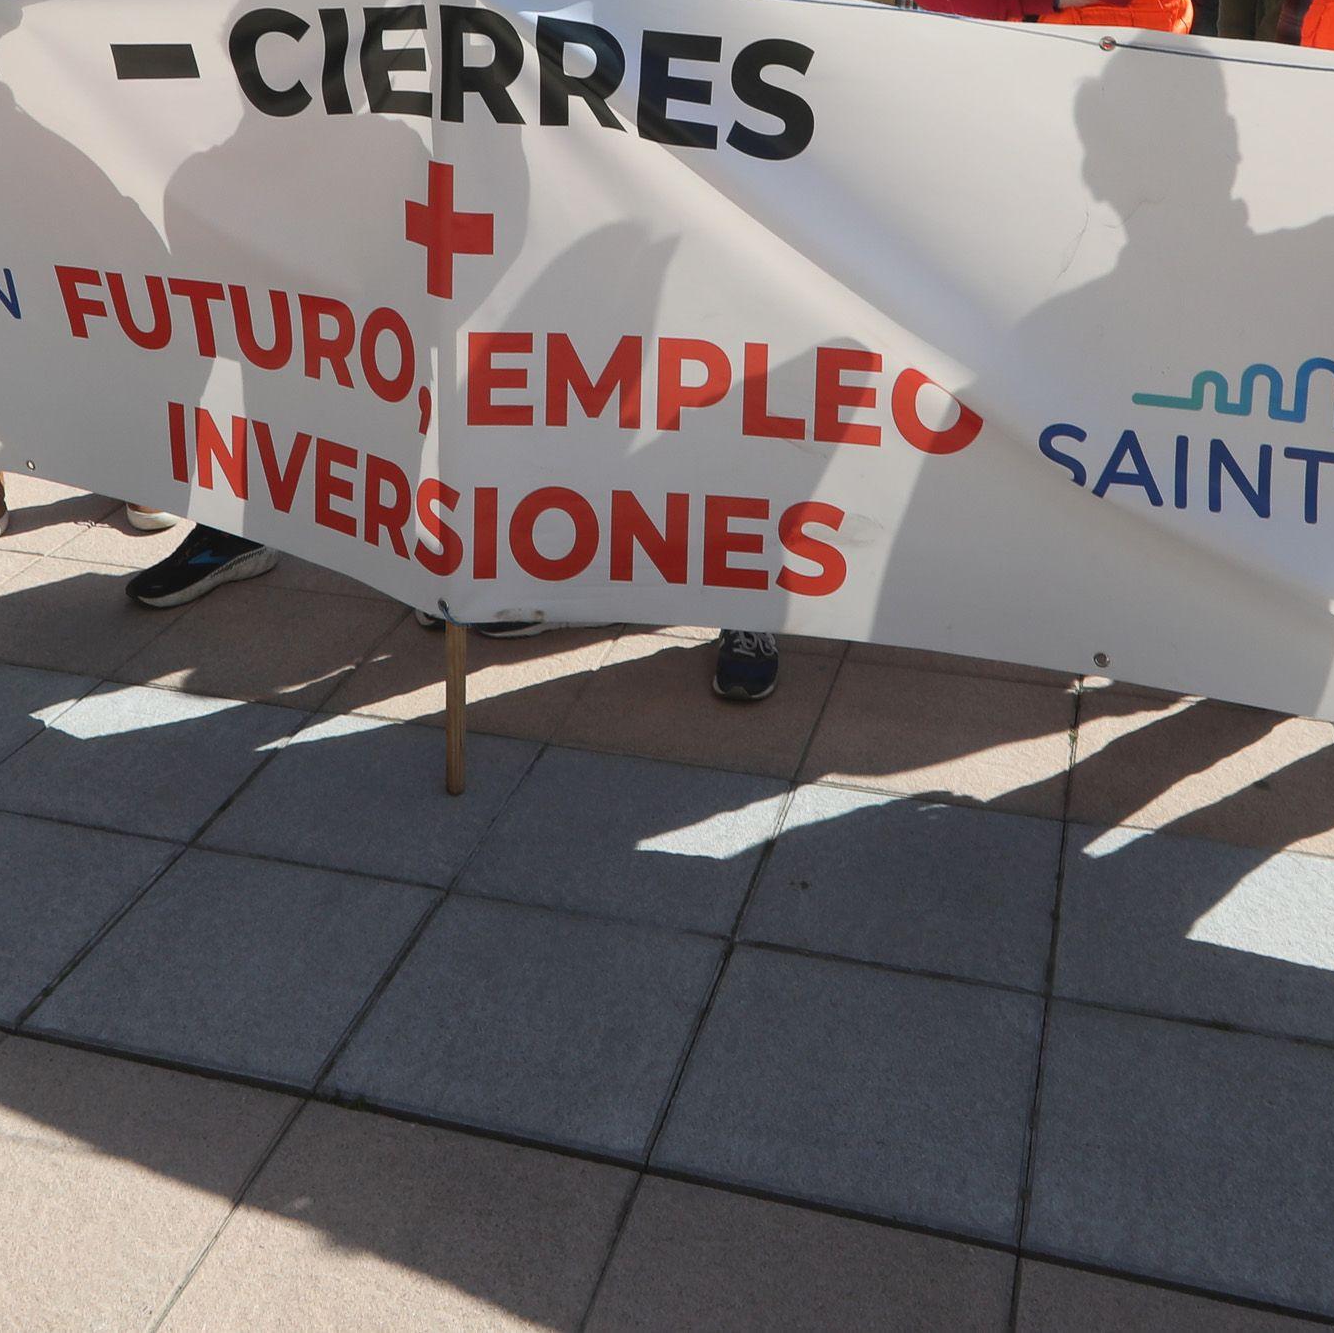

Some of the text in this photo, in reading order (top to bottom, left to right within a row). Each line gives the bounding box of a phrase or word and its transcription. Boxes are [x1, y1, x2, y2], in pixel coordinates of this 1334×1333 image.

[227, 4, 816, 162] CIERRES
[54, 265, 984, 456] FUTURO, EMPLEO
[168, 402, 848, 597] INVERSIONES
